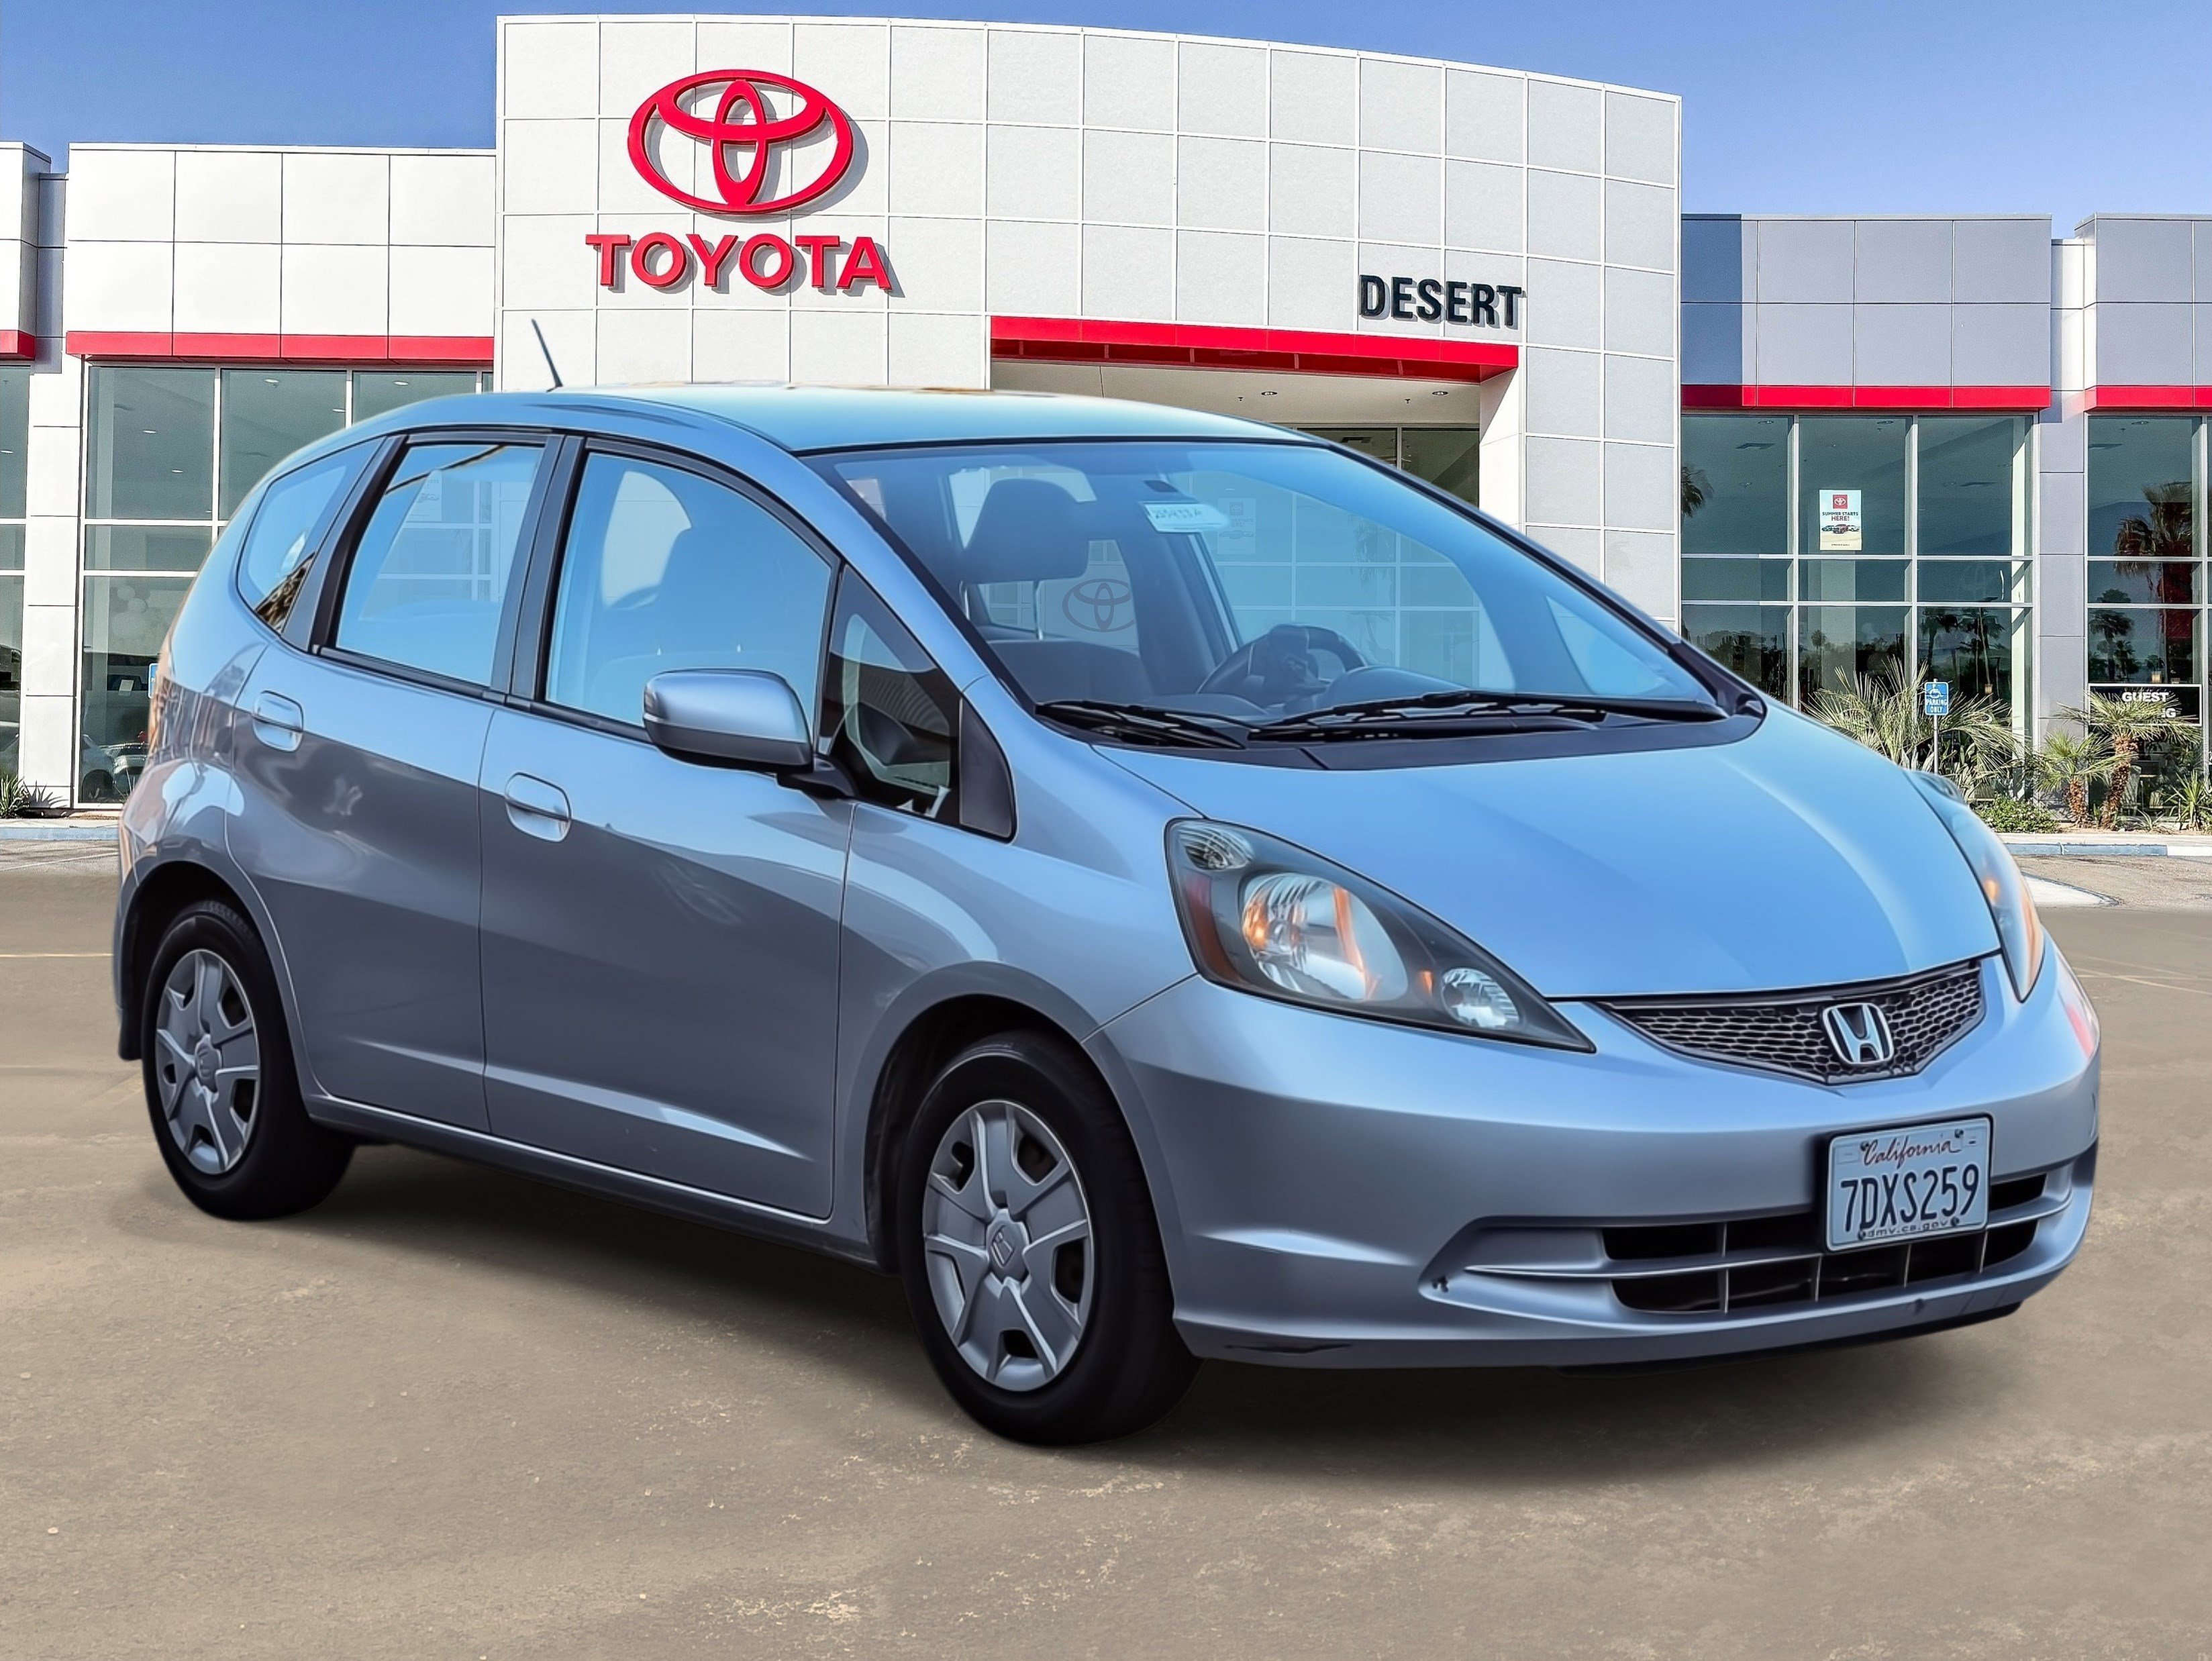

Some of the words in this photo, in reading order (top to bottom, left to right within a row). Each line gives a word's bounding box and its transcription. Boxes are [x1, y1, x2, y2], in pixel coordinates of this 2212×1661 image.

[586, 232, 893, 290] TOYOTA
[1359, 274, 1522, 327] DESERT
[2121, 692, 2169, 703] GUEST
[1863, 1131, 1961, 1169] California
[1840, 1164, 1980, 1232] 7DXS259
[1868, 1219, 1948, 1238] dmv.ca.gov
